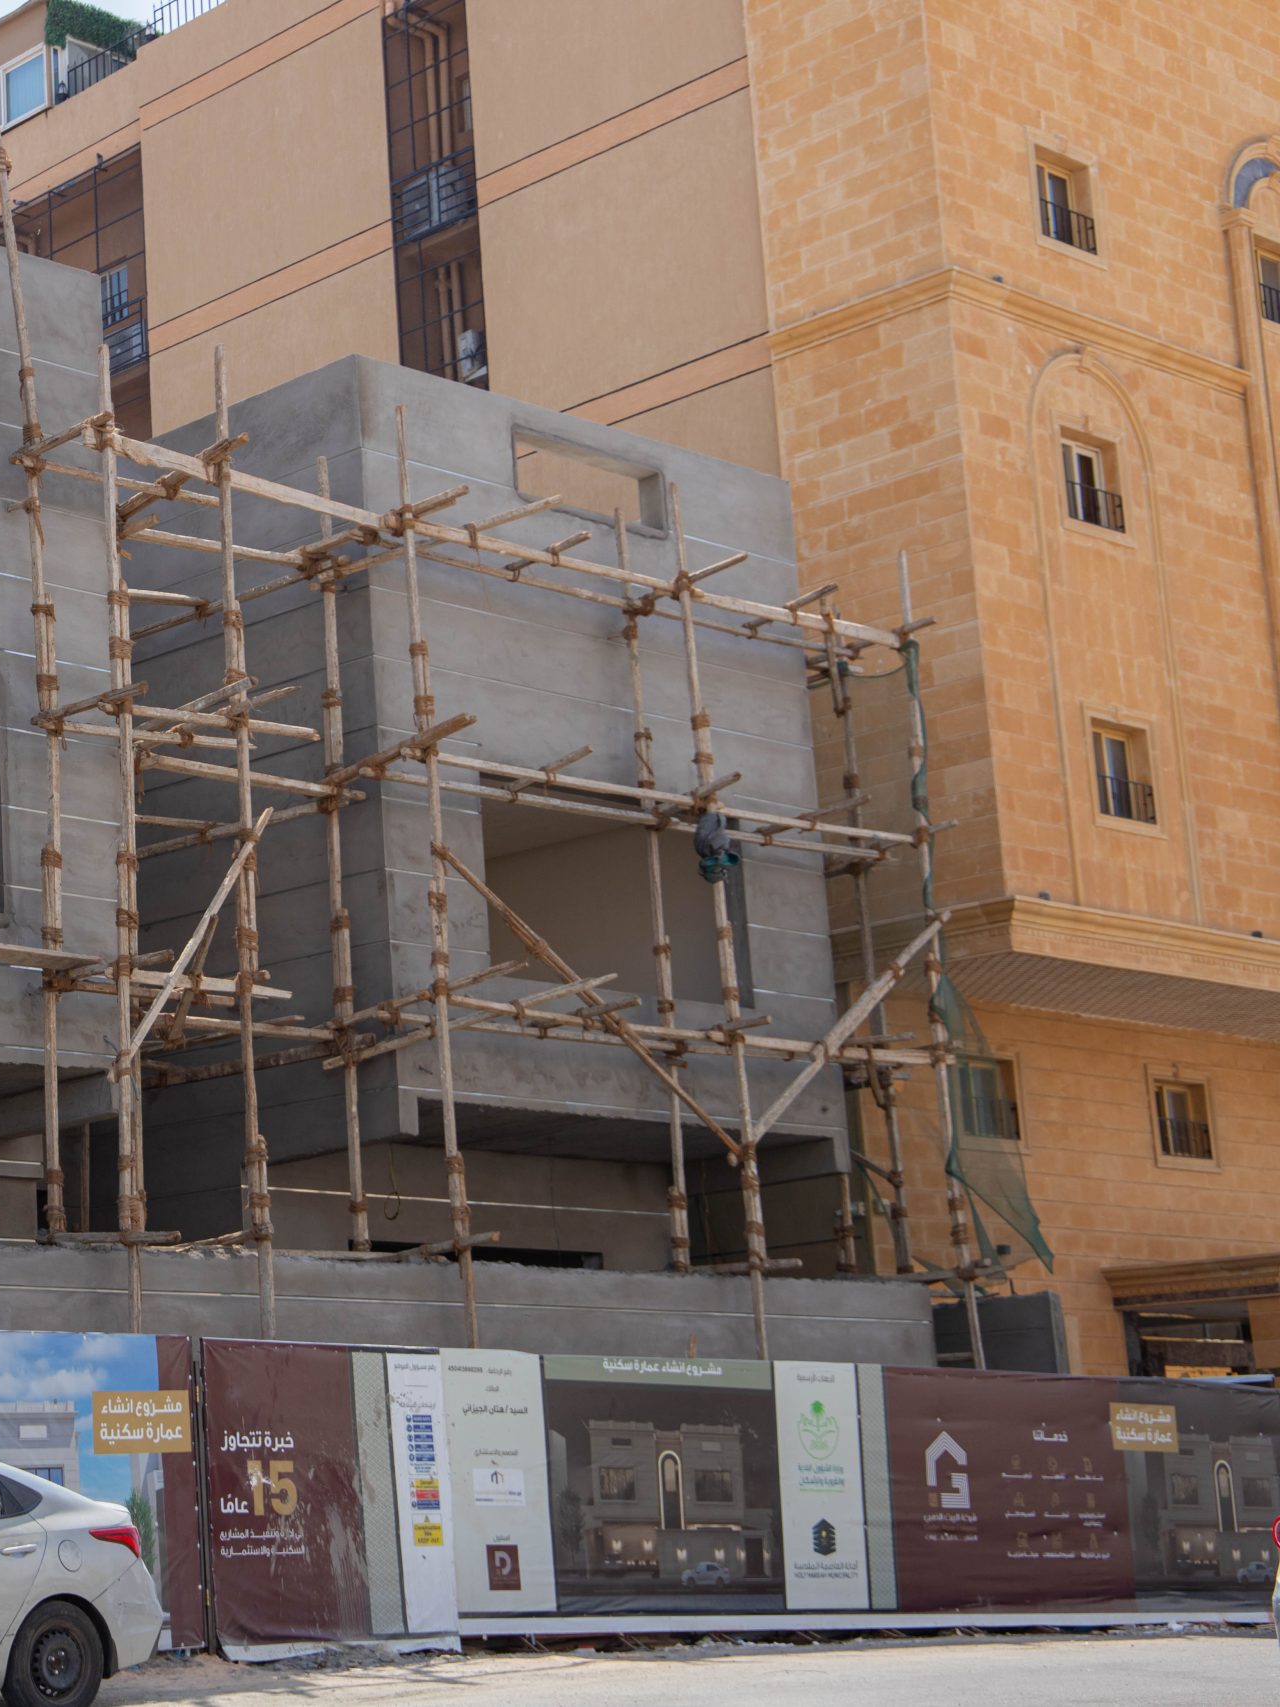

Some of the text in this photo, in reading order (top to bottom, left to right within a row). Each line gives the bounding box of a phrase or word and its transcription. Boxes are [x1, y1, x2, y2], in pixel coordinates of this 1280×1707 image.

[602, 1357, 633, 1373] سكنية
[634, 1358, 660, 1374] عمارة
[686, 1361, 724, 1376] مشروع
[100, 1395, 134, 1415] انشاء
[1139, 1408, 1172, 1425] مشروع
[99, 1421, 184, 1446] عمارة سكنية
[220, 1430, 295, 1453] خبرة تتجاوز
[1146, 1427, 1173, 1445] عمارة
[246, 1460, 298, 1516] 15
[219, 1528, 249, 1541] المشاريع
[220, 1544, 271, 1558] والاستثمارية
